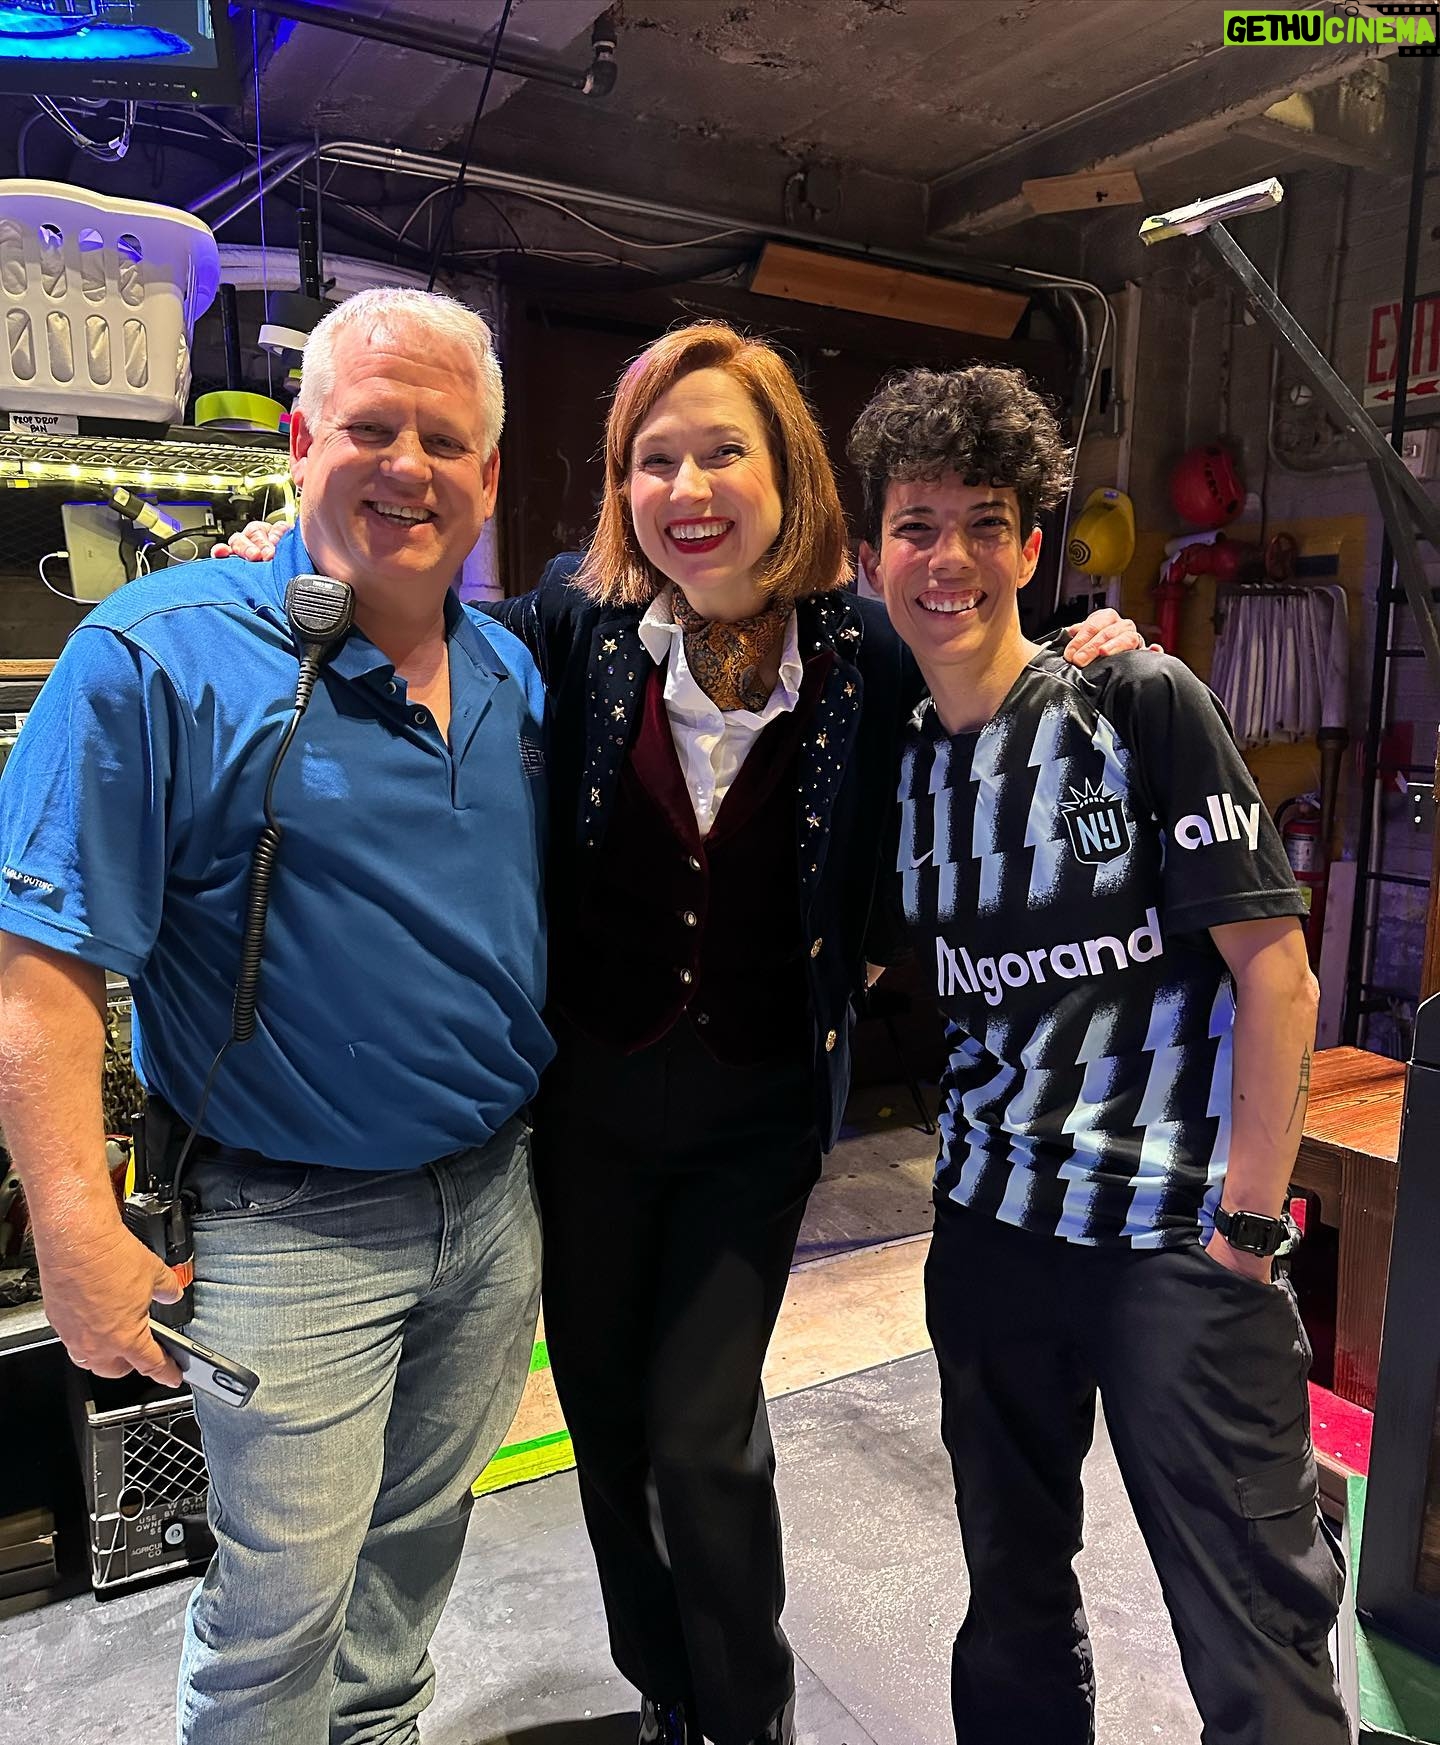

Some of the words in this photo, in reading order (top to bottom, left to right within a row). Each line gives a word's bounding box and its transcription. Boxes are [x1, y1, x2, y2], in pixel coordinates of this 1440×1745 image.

[13, 416, 33, 424] PROP
[34, 417, 59, 425] DROP
[30, 424, 48, 433] BIN
[1175, 793, 1260, 851] ally
[936, 907, 1164, 1006] Algorand
[139, 1514, 157, 1524] USE
[164, 1509, 176, 1517] BY
[136, 1519, 163, 1532] OWNE
